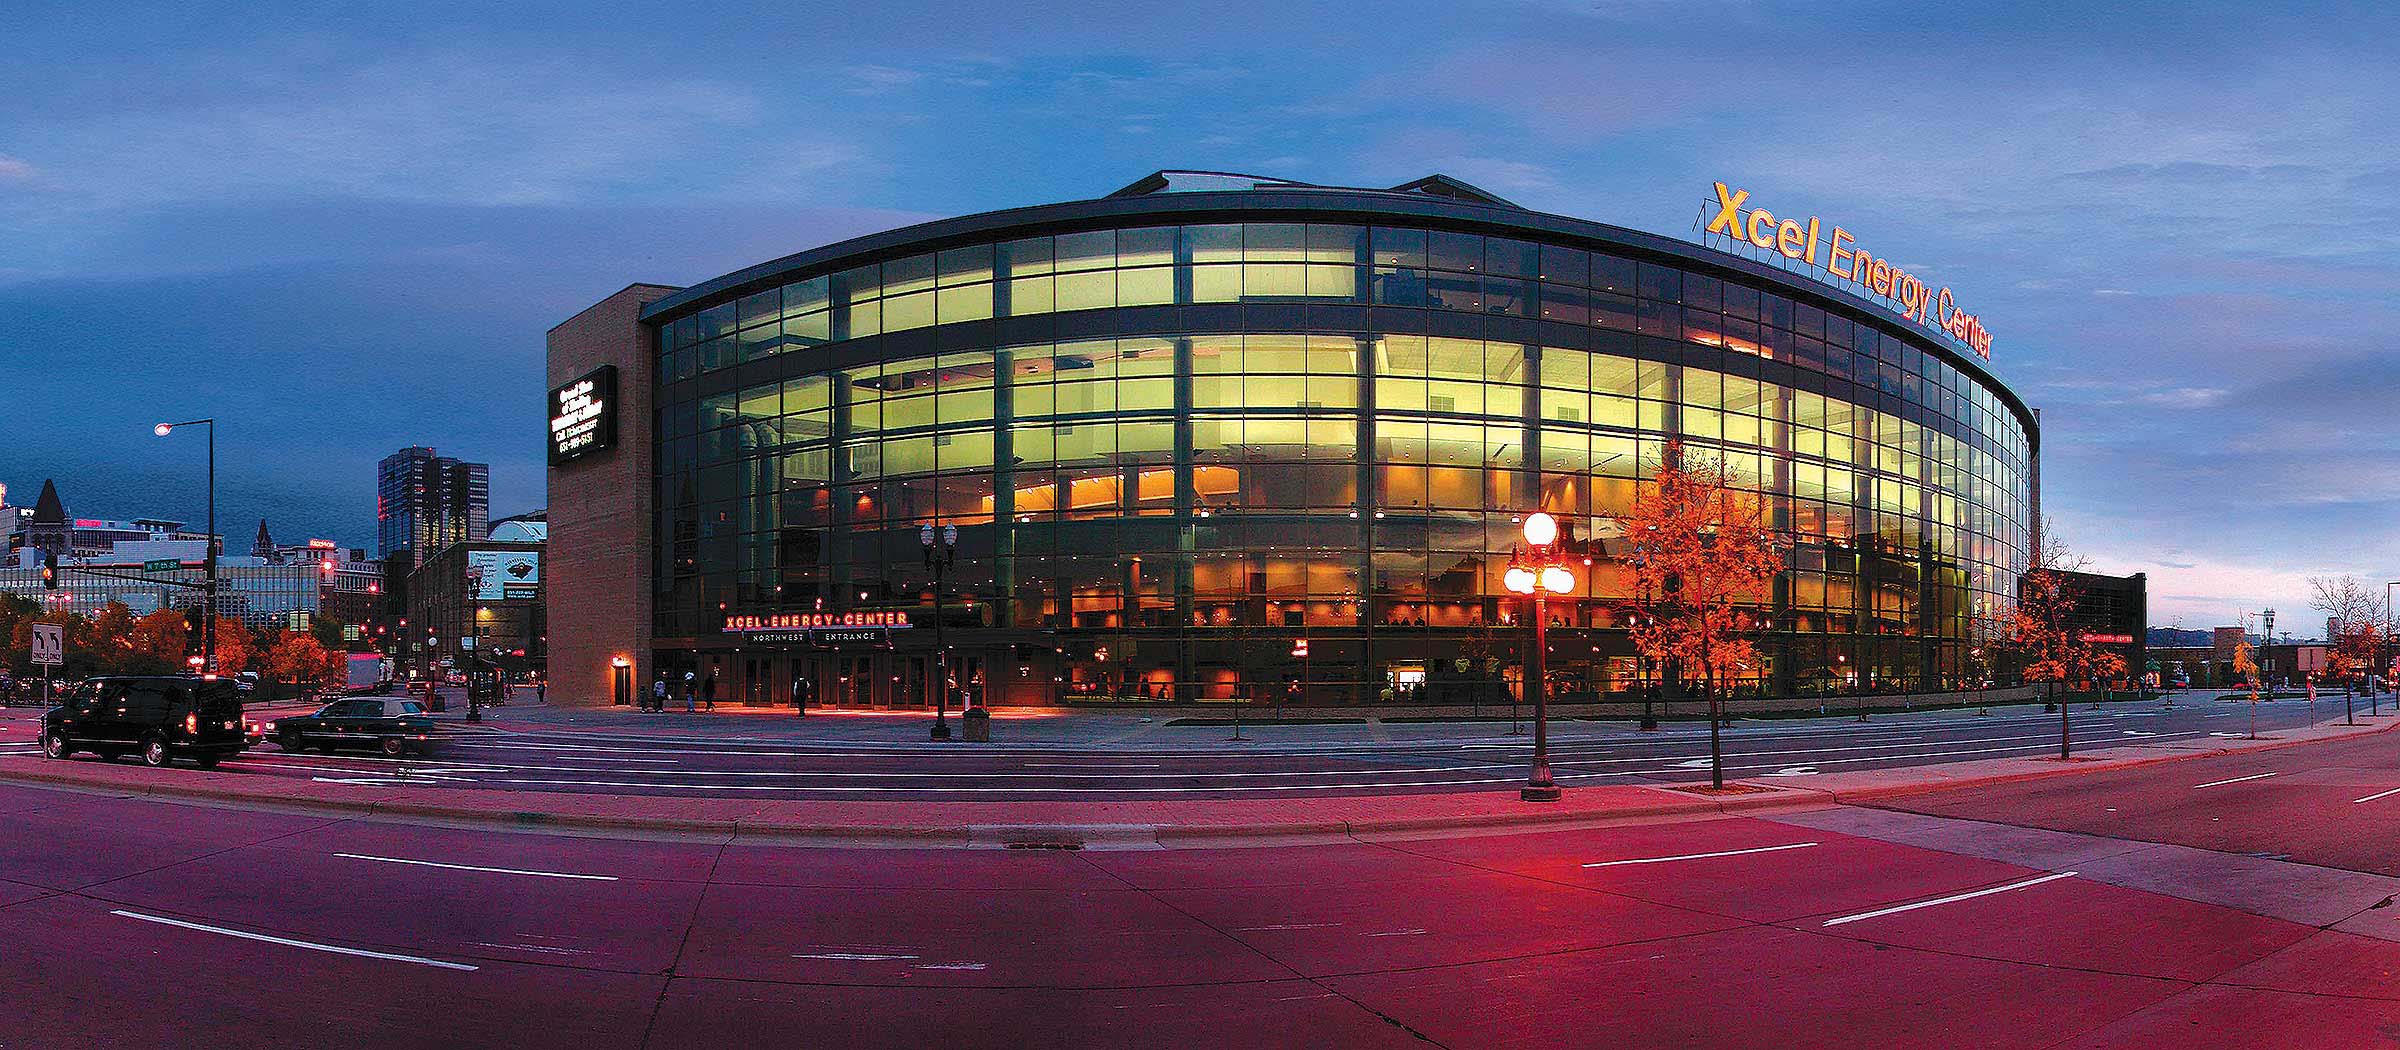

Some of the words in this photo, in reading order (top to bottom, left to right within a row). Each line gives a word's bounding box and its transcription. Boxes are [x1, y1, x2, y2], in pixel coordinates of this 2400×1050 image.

[1706, 180, 1820, 265] Xcel
[1827, 225, 1932, 325] Energy
[1938, 286, 1995, 364] Center
[726, 615, 763, 629] XCEL
[771, 613, 835, 627] ENERGY
[844, 611, 909, 625] CENTER
[753, 634, 804, 642] NORTHWEST
[825, 632, 875, 641] ENTRANCE
